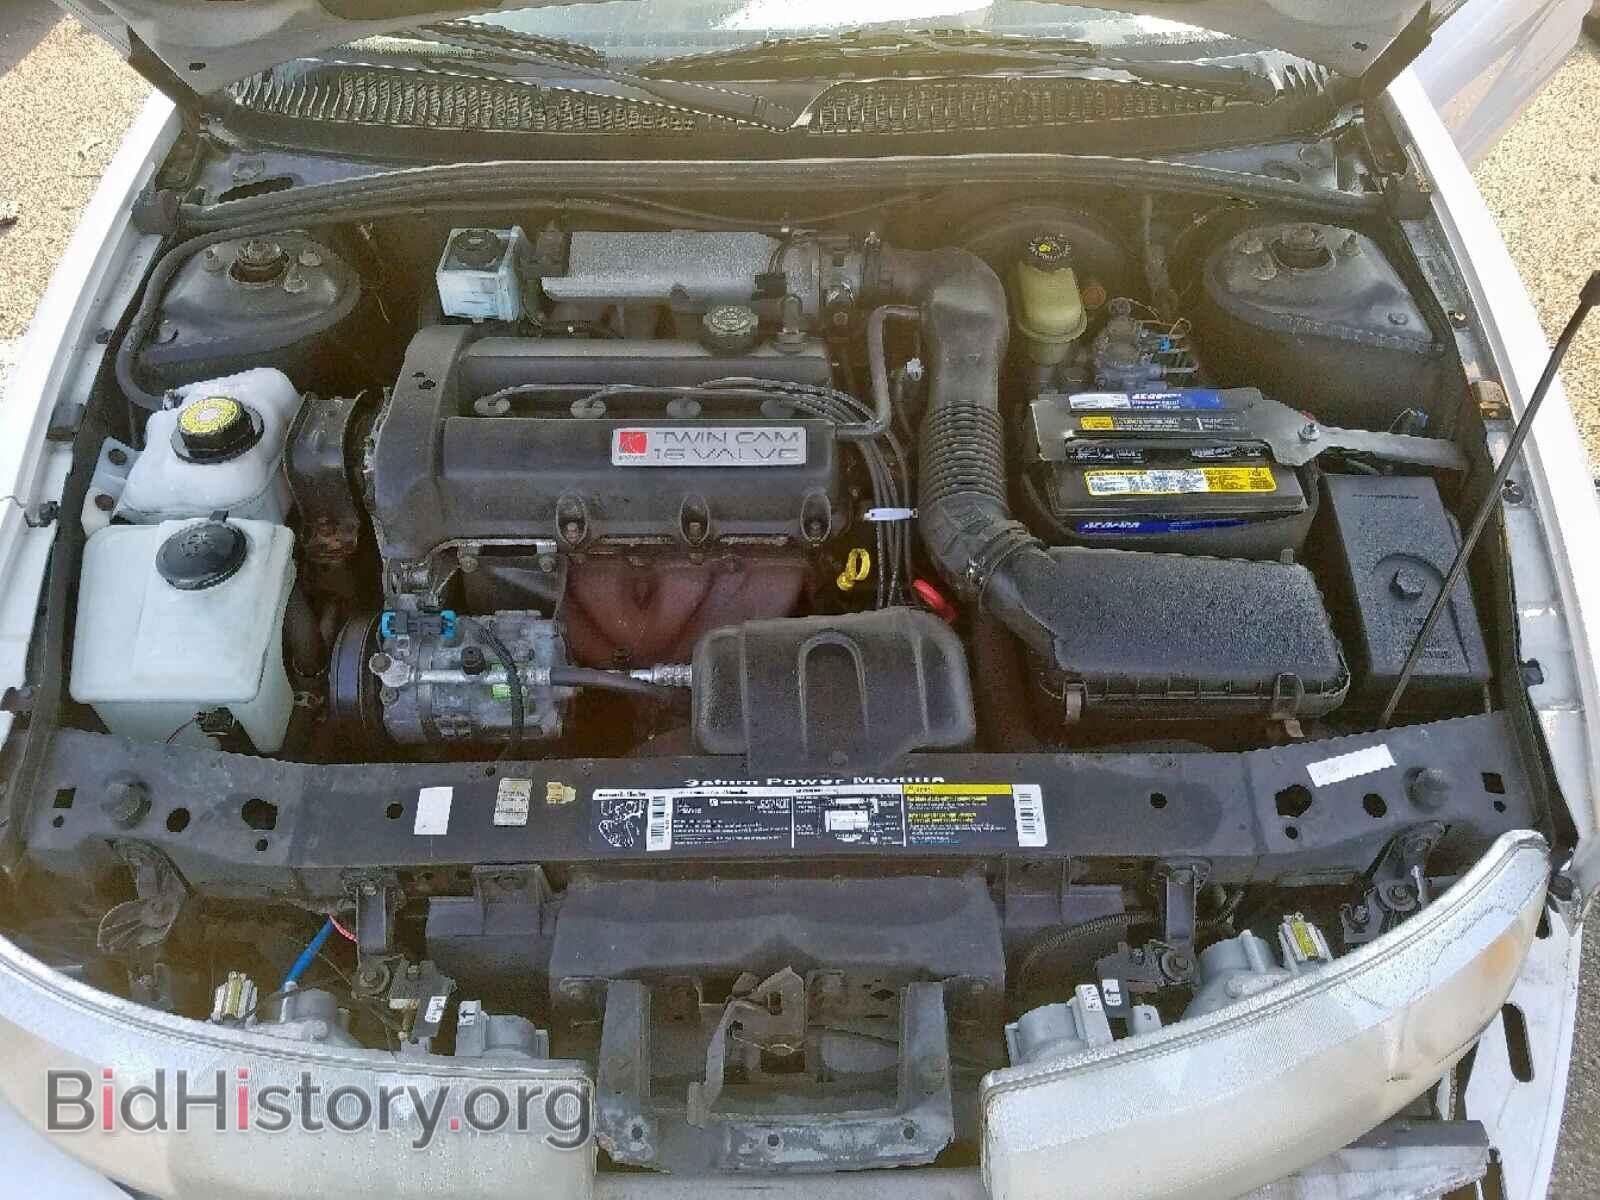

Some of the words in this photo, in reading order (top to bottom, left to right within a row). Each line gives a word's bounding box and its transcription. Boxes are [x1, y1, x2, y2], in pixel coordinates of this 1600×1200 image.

[655, 431, 728, 444] TWIN
[735, 431, 800, 444] CAM
[654, 448, 686, 460] 16
[693, 448, 800, 461] VALVE
[766, 777, 846, 786] Power
